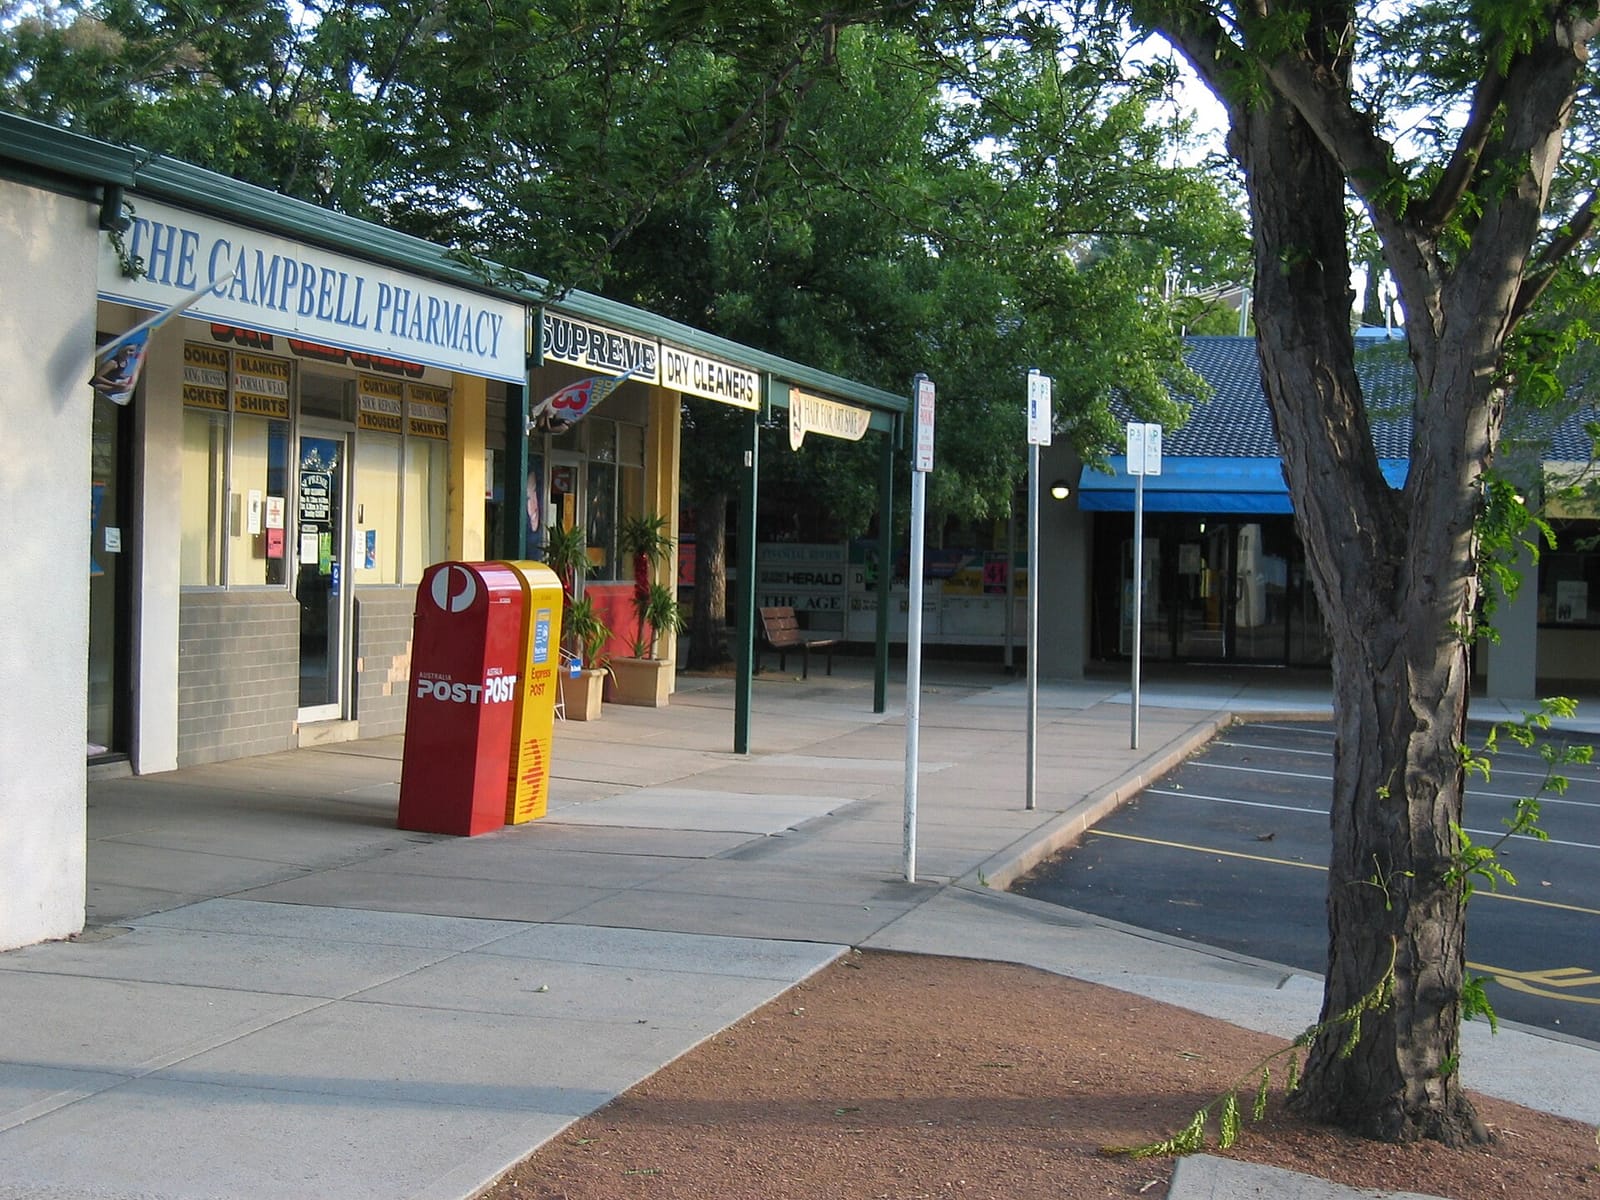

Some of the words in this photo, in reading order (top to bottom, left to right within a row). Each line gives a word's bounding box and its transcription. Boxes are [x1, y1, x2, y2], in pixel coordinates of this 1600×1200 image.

[129, 217, 200, 291] THE
[207, 238, 369, 330] CAMPBELL
[373, 281, 504, 359] PHARMACY
[543, 315, 656, 379] SUPREME
[240, 358, 289, 377] BLANKETS
[667, 351, 689, 387] DRY
[693, 361, 753, 403] CLEANERS
[184, 387, 225, 405] ACKETS
[267, 381, 286, 395] WEAR
[241, 397, 285, 413] SHIRTS
[411, 421, 444, 436] SKIRTS
[786, 572, 842, 586] HERALD
[764, 595, 798, 608] THE
[805, 595, 841, 609] AGE
[419, 672, 452, 681] AUSTRALIA
[531, 667, 551, 681] Express
[417, 679, 482, 704] POST
[484, 675, 517, 704] POST
[529, 683, 546, 697] POST
